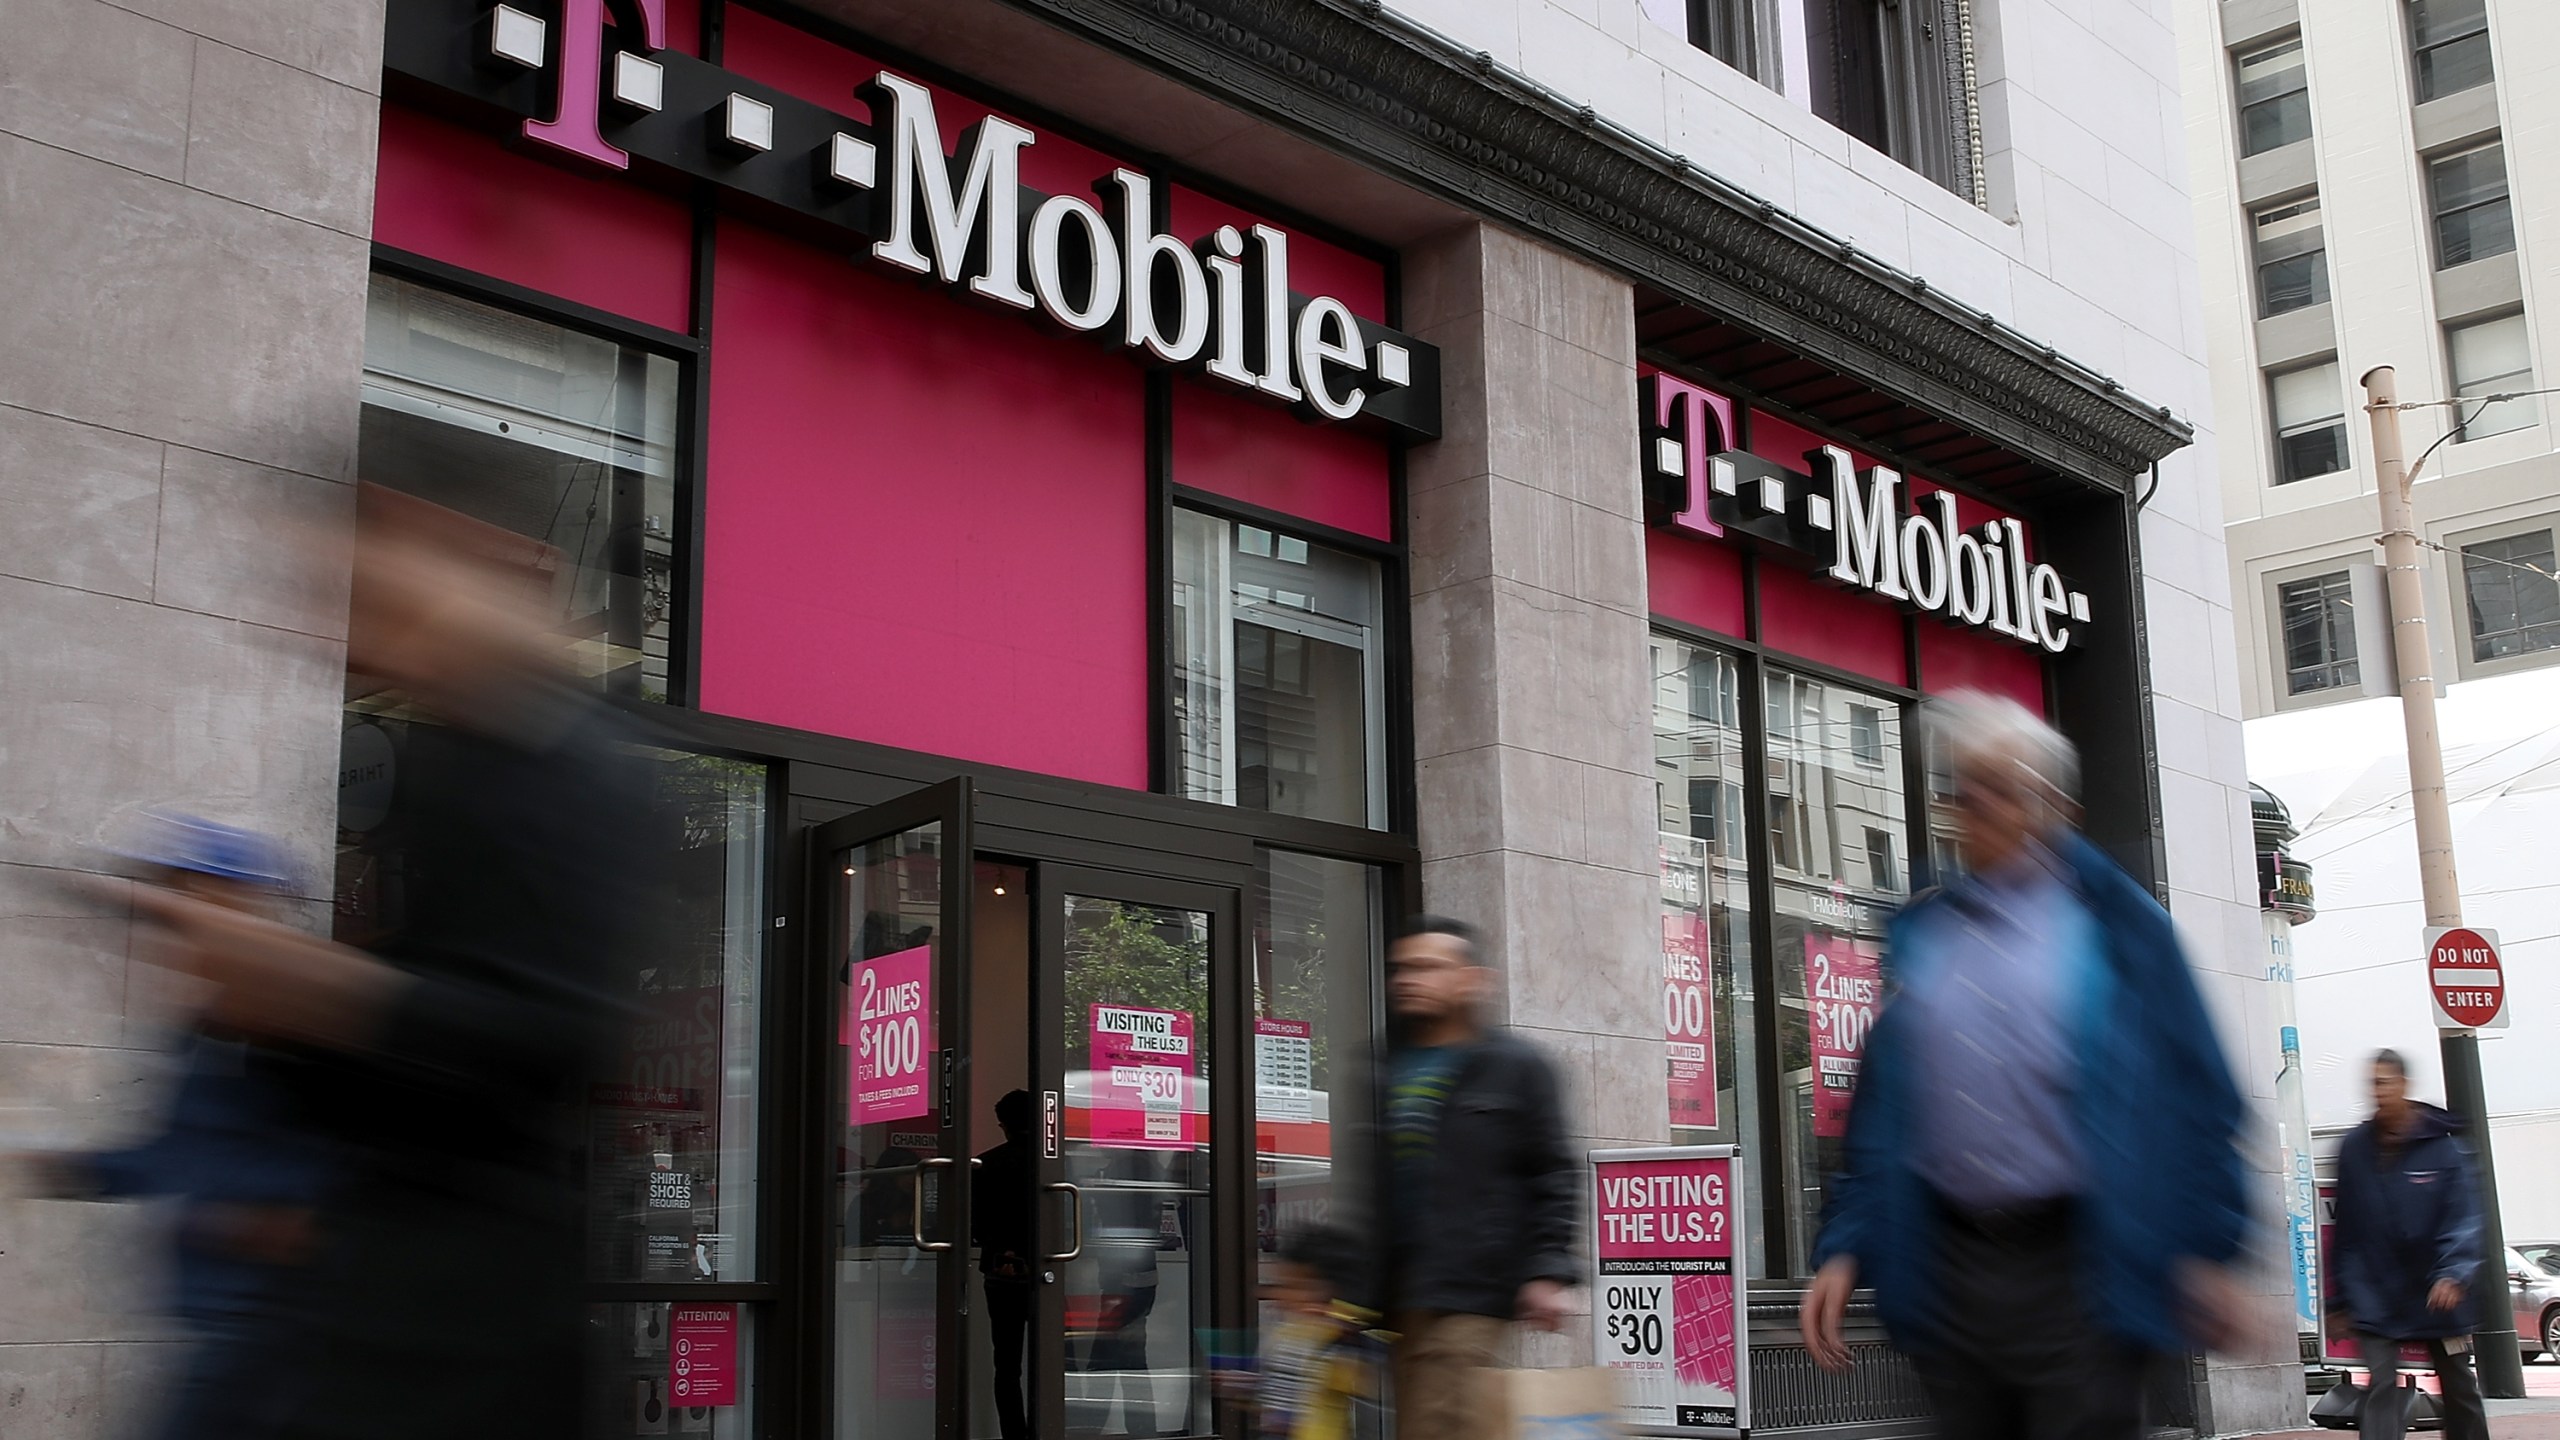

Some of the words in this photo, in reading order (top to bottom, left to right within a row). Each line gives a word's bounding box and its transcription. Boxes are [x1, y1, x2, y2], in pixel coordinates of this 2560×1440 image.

[2437, 948, 2457, 963] DO
[2463, 948, 2489, 963] NOT
[1663, 952, 1702, 982] INES
[1814, 953, 1831, 998] 2
[1829, 975, 1874, 1004] LINES
[859, 967, 876, 1021] 2
[876, 980, 920, 1018] LINES
[2446, 991, 2494, 1007] ENTER
[1104, 1012, 1165, 1033] VISITING
[1260, 1022, 1281, 1033] STORE
[1281, 1024, 1303, 1034] HOURS
[859, 1016, 920, 1079] $100
[1138, 1036, 1158, 1050] THE
[1160, 1038, 1184, 1052] U.S.?
[858, 1062, 874, 1081] FOR
[1115, 1069, 1141, 1083] ONLY
[1144, 1071, 1177, 1099] $30
[1046, 1097, 1055, 1152] PULL
[650, 1171, 683, 1185] SHIRT
[684, 1173, 691, 1186] &
[649, 1185, 691, 1199] SHOES
[1602, 1173, 1724, 1209] VISITING
[649, 1198, 691, 1209] REQUIRED
[1603, 1212, 1656, 1243] THE
[1660, 1211, 1725, 1243] U.S.?
[1605, 1261, 1655, 1272] INTRODUCING
[1656, 1261, 1671, 1272] THE
[1671, 1261, 1704, 1271] TOURIST
[1704, 1261, 1726, 1271] PLAN
[1606, 1285, 1663, 1311] ONLY
[677, 1310, 730, 1322] ATTENTION
[1607, 1312, 1664, 1357] $30
[1647, 1361, 1665, 1370] DATA
